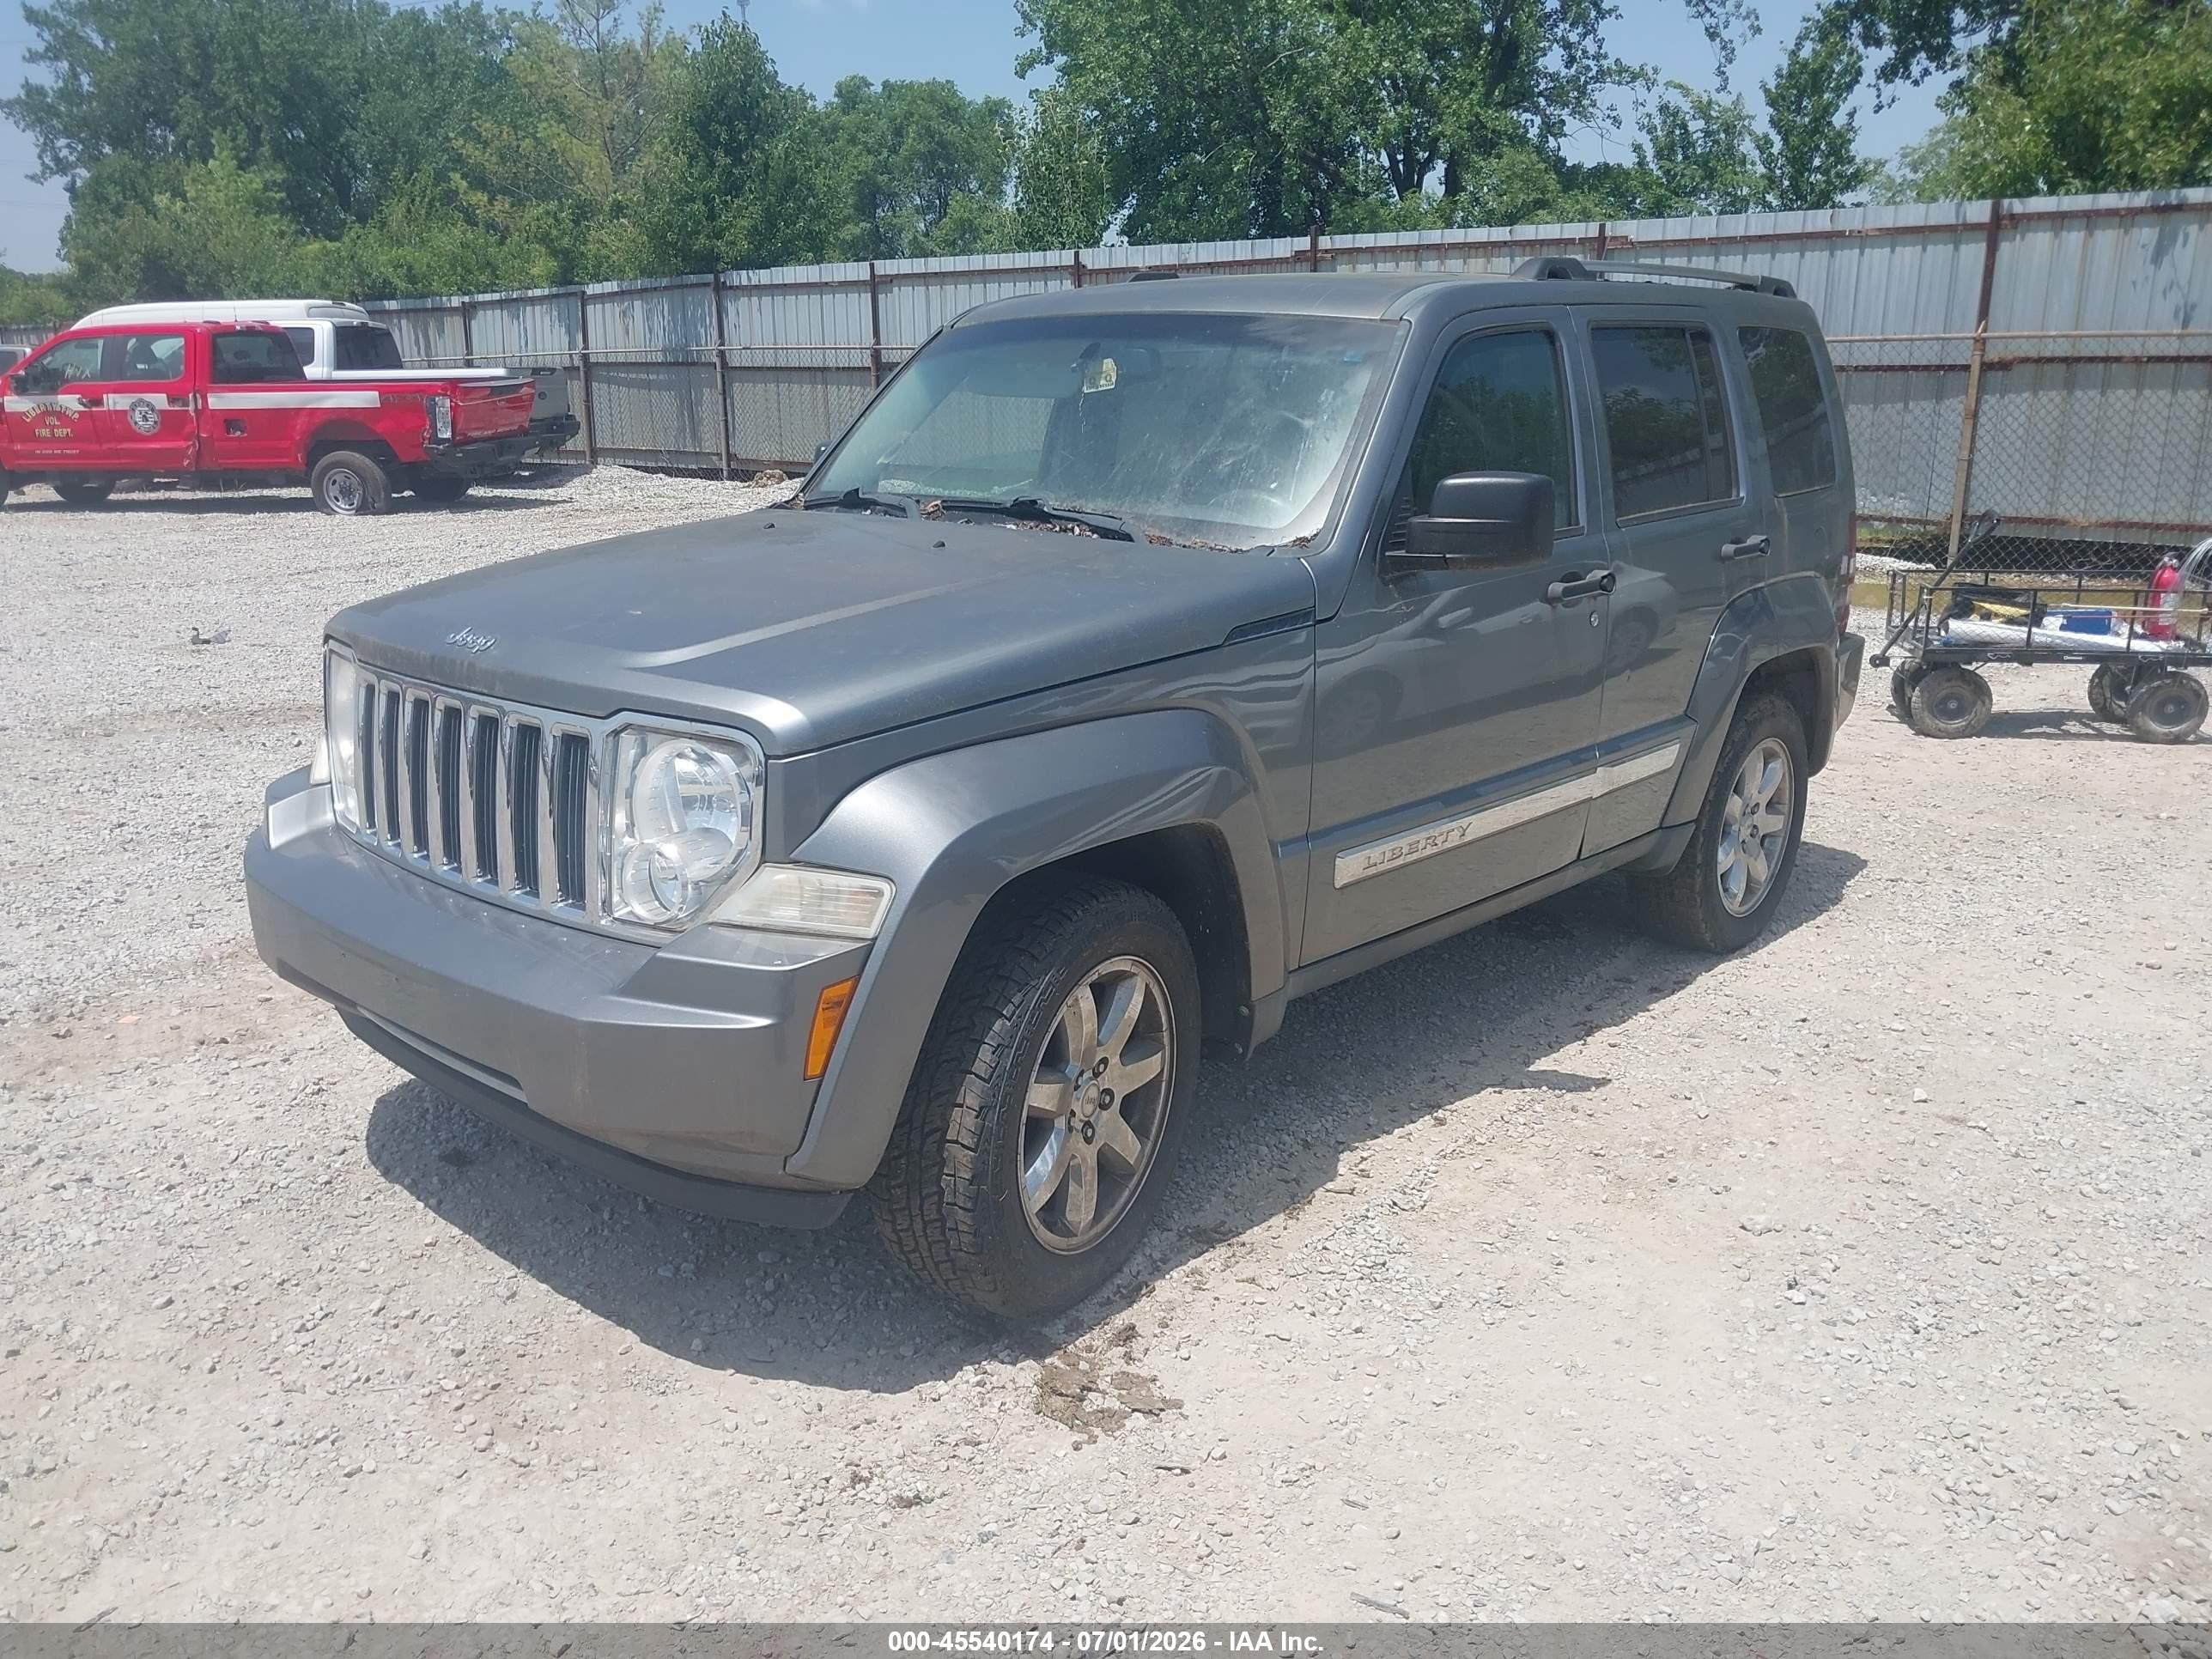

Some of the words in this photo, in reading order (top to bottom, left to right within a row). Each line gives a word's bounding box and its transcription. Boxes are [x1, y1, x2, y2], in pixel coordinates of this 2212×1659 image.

[21, 402, 58, 422] LIBERTY
[44, 416, 61, 426] VOL.
[34, 428, 52, 438] FIRE
[53, 428, 74, 438] DEPT.
[446, 626, 496, 654] Jeep
[1362, 821, 1474, 871] LIBERTY
